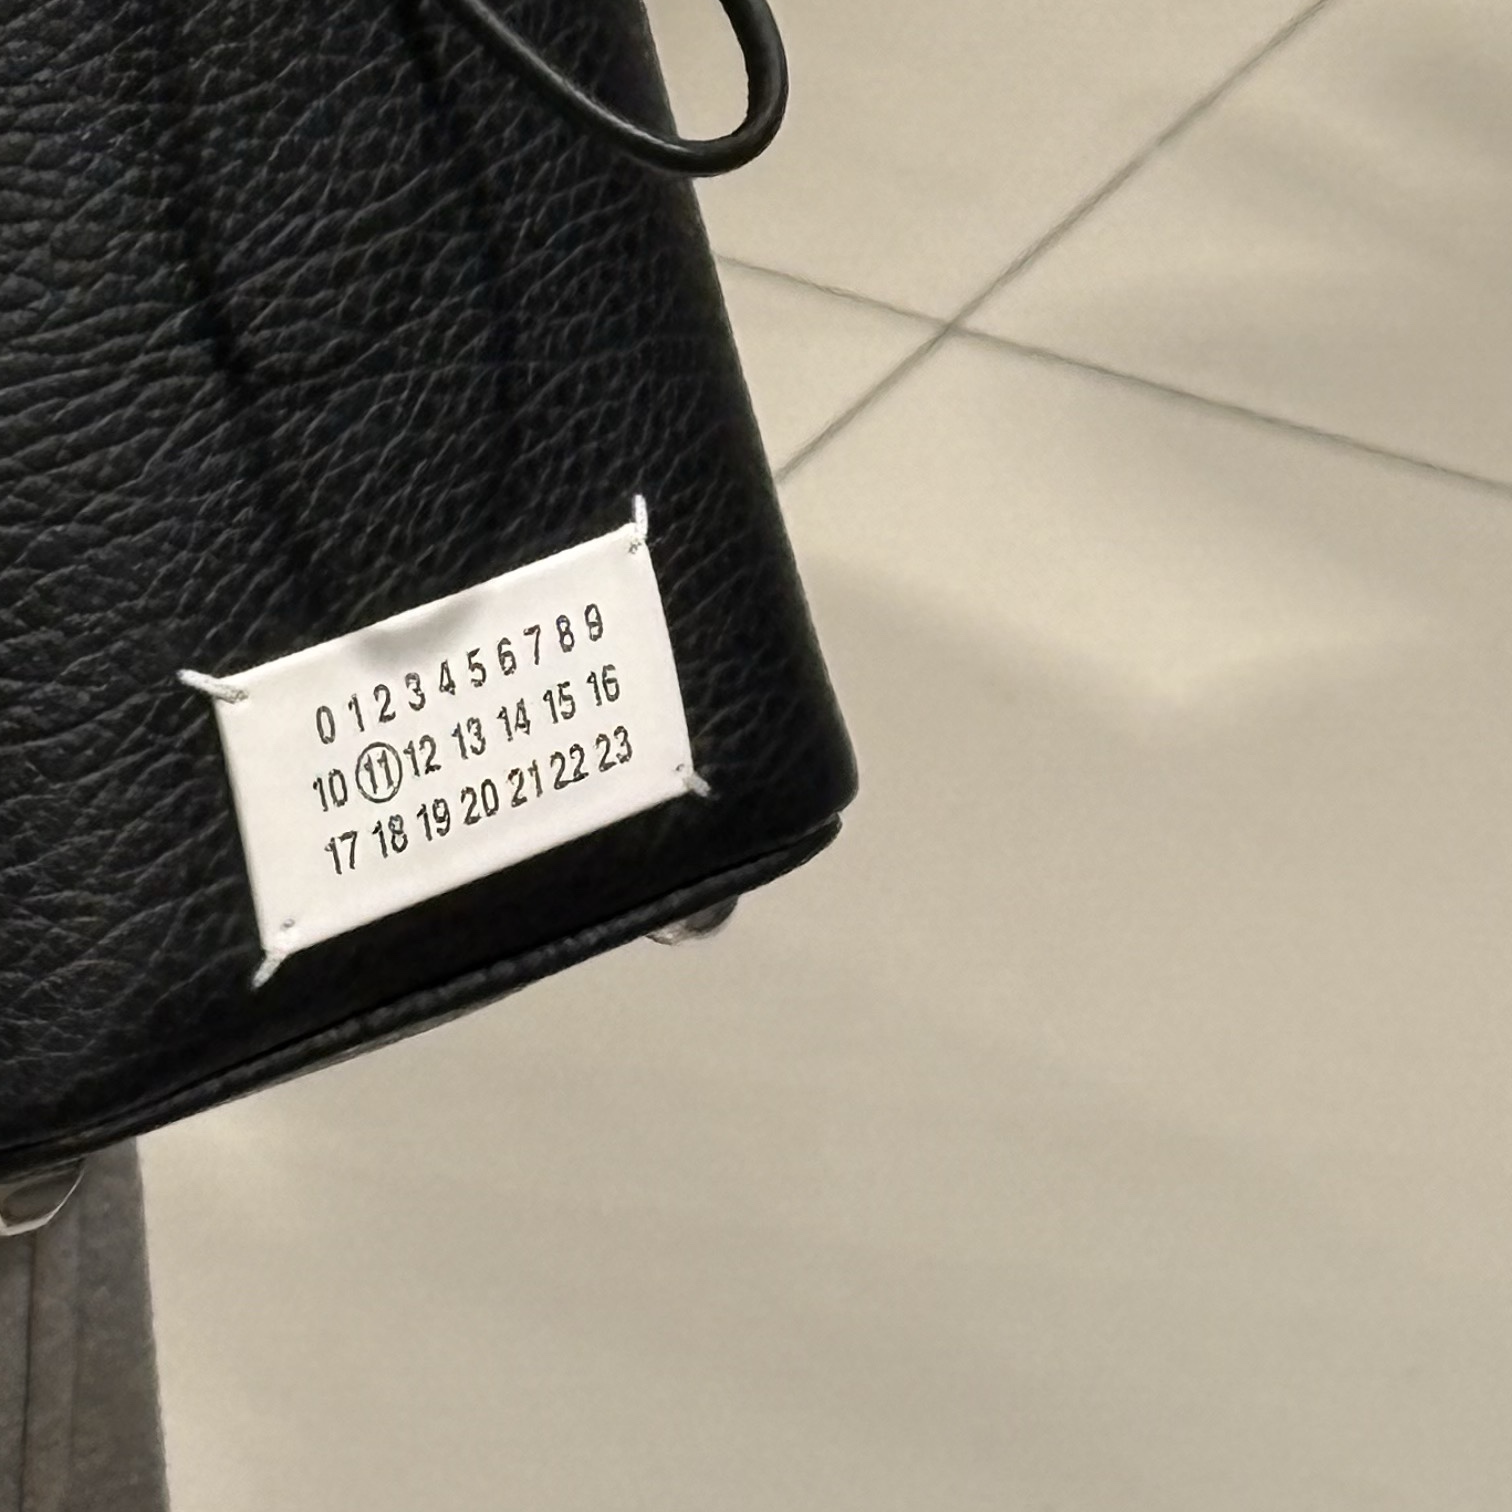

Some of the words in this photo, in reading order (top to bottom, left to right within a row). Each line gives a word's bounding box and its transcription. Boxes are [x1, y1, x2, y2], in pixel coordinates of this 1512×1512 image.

[313, 769, 348, 812] 10
[403, 735, 441, 776] 12
[451, 717, 486, 759] 13
[497, 698, 530, 742] 14
[543, 681, 575, 724] 15
[587, 664, 620, 706] 16
[316, 706, 335, 744] 0
[348, 694, 364, 732] 1
[373, 684, 396, 723] 2
[405, 673, 425, 711] 3
[439, 660, 456, 695] 4
[467, 648, 486, 687] 5
[497, 638, 516, 676] 6
[524, 625, 541, 665] 7
[556, 615, 575, 653] 8
[584, 604, 603, 641] 9
[325, 831, 357, 874] 17
[372, 814, 408, 858] 18
[417, 798, 450, 841] 19
[461, 779, 499, 825] 20
[508, 760, 543, 807] 21
[550, 744, 589, 790] 22
[596, 726, 632, 772] 23
